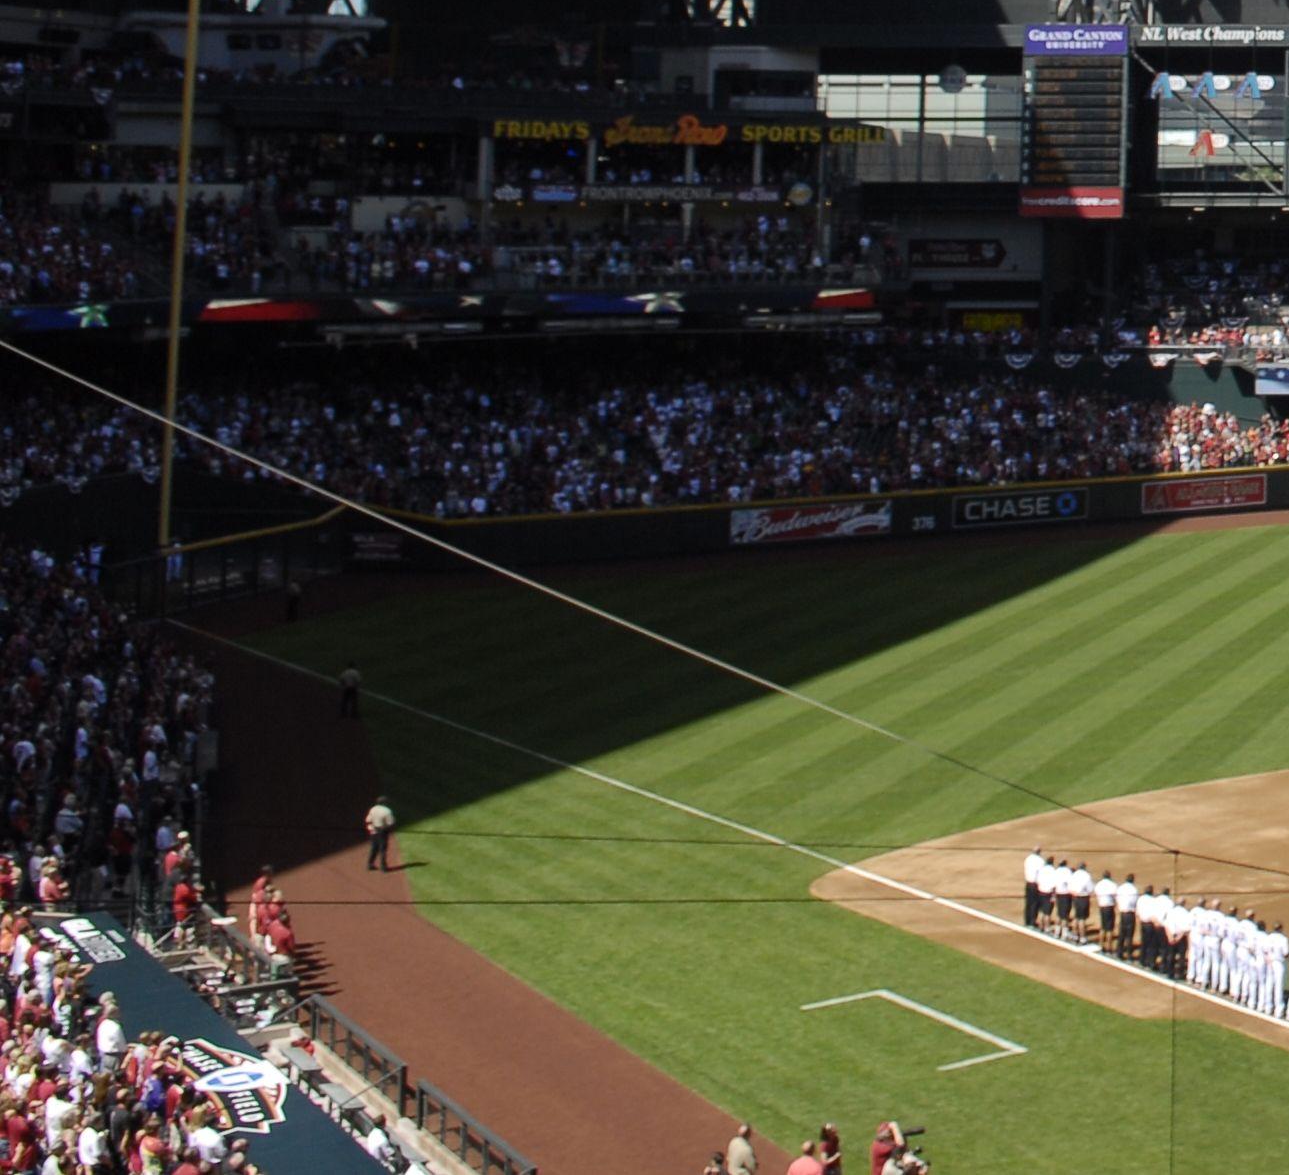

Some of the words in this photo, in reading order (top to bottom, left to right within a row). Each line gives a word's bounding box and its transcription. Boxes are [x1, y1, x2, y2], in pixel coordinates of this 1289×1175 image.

[1028, 28, 1073, 42] GRAND
[1073, 28, 1124, 42] CANYON
[1141, 26, 1164, 42] NL
[1166, 26, 1202, 42] West
[1203, 26, 1285, 44] Champions
[493, 120, 590, 140] FRIDAY'S
[674, 114, 727, 146] Row
[741, 124, 821, 143] SPORTS
[829, 126, 885, 144] GRILL
[964, 496, 1051, 521] CHASE
[754, 504, 866, 540] Budweiser
[912, 515, 936, 530] 376
[227, 1090, 265, 1123] FIELD
